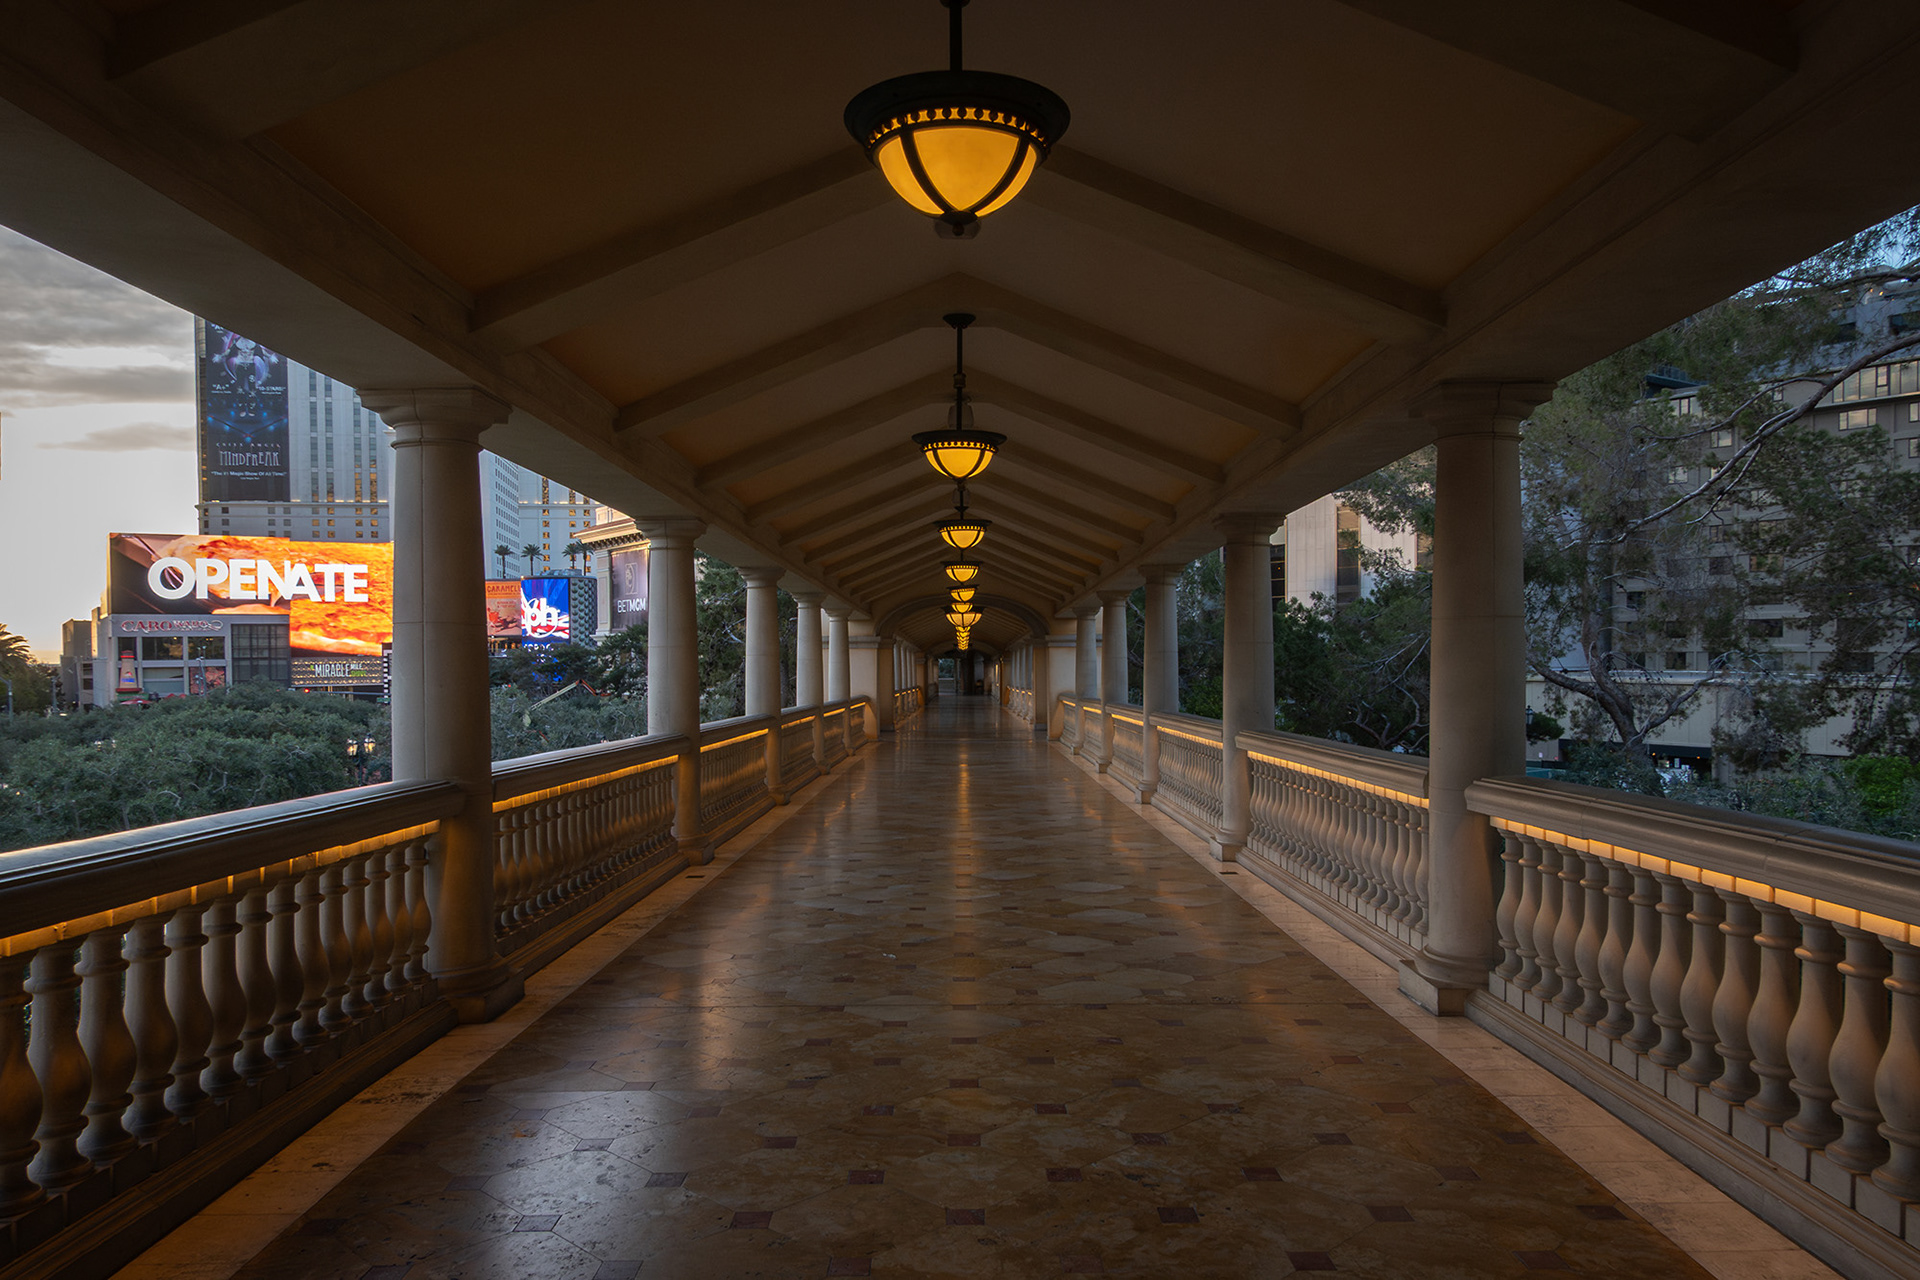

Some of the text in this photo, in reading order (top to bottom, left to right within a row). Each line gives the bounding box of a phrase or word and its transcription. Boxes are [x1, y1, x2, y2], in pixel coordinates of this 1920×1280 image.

[219, 450, 281, 466] MINDFREAK
[617, 598, 646, 613] BETMGM
[121, 620, 172, 633] CABO
[315, 663, 350, 677] MIRACLE
